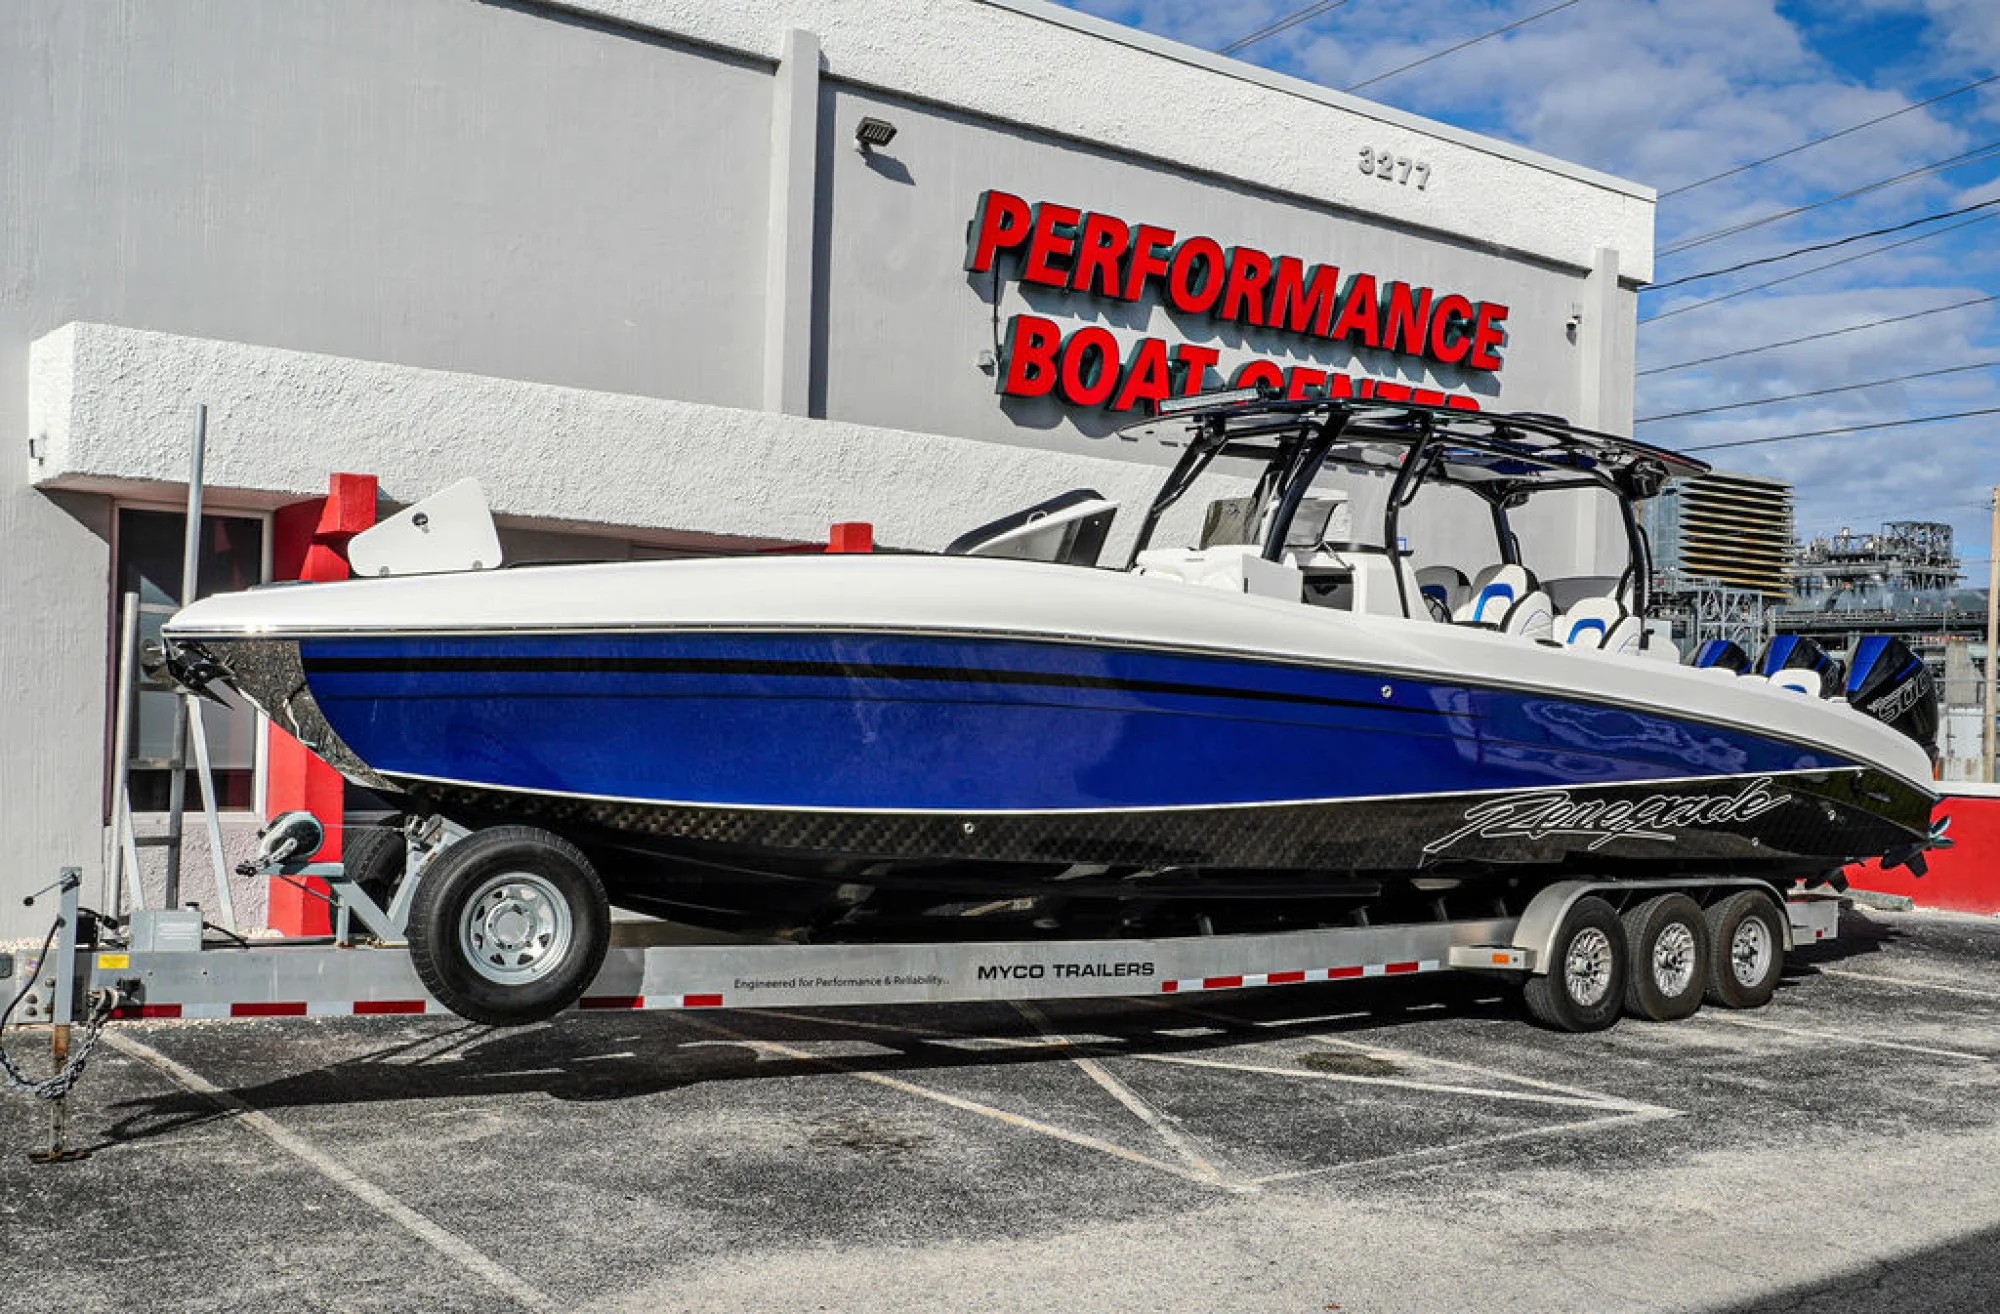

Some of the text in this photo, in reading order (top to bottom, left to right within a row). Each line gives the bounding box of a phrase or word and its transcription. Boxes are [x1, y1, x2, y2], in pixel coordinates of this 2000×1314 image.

[1359, 146, 1430, 191] 3277
[967, 189, 1509, 371] PERFORMANCE
[1003, 314, 1219, 412] BOAT
[734, 978, 796, 990] Engineered
[798, 976, 814, 987] for
[815, 975, 882, 987] Performance
[884, 975, 892, 985] &
[977, 963, 1155, 980] MYCO TRAILERS
